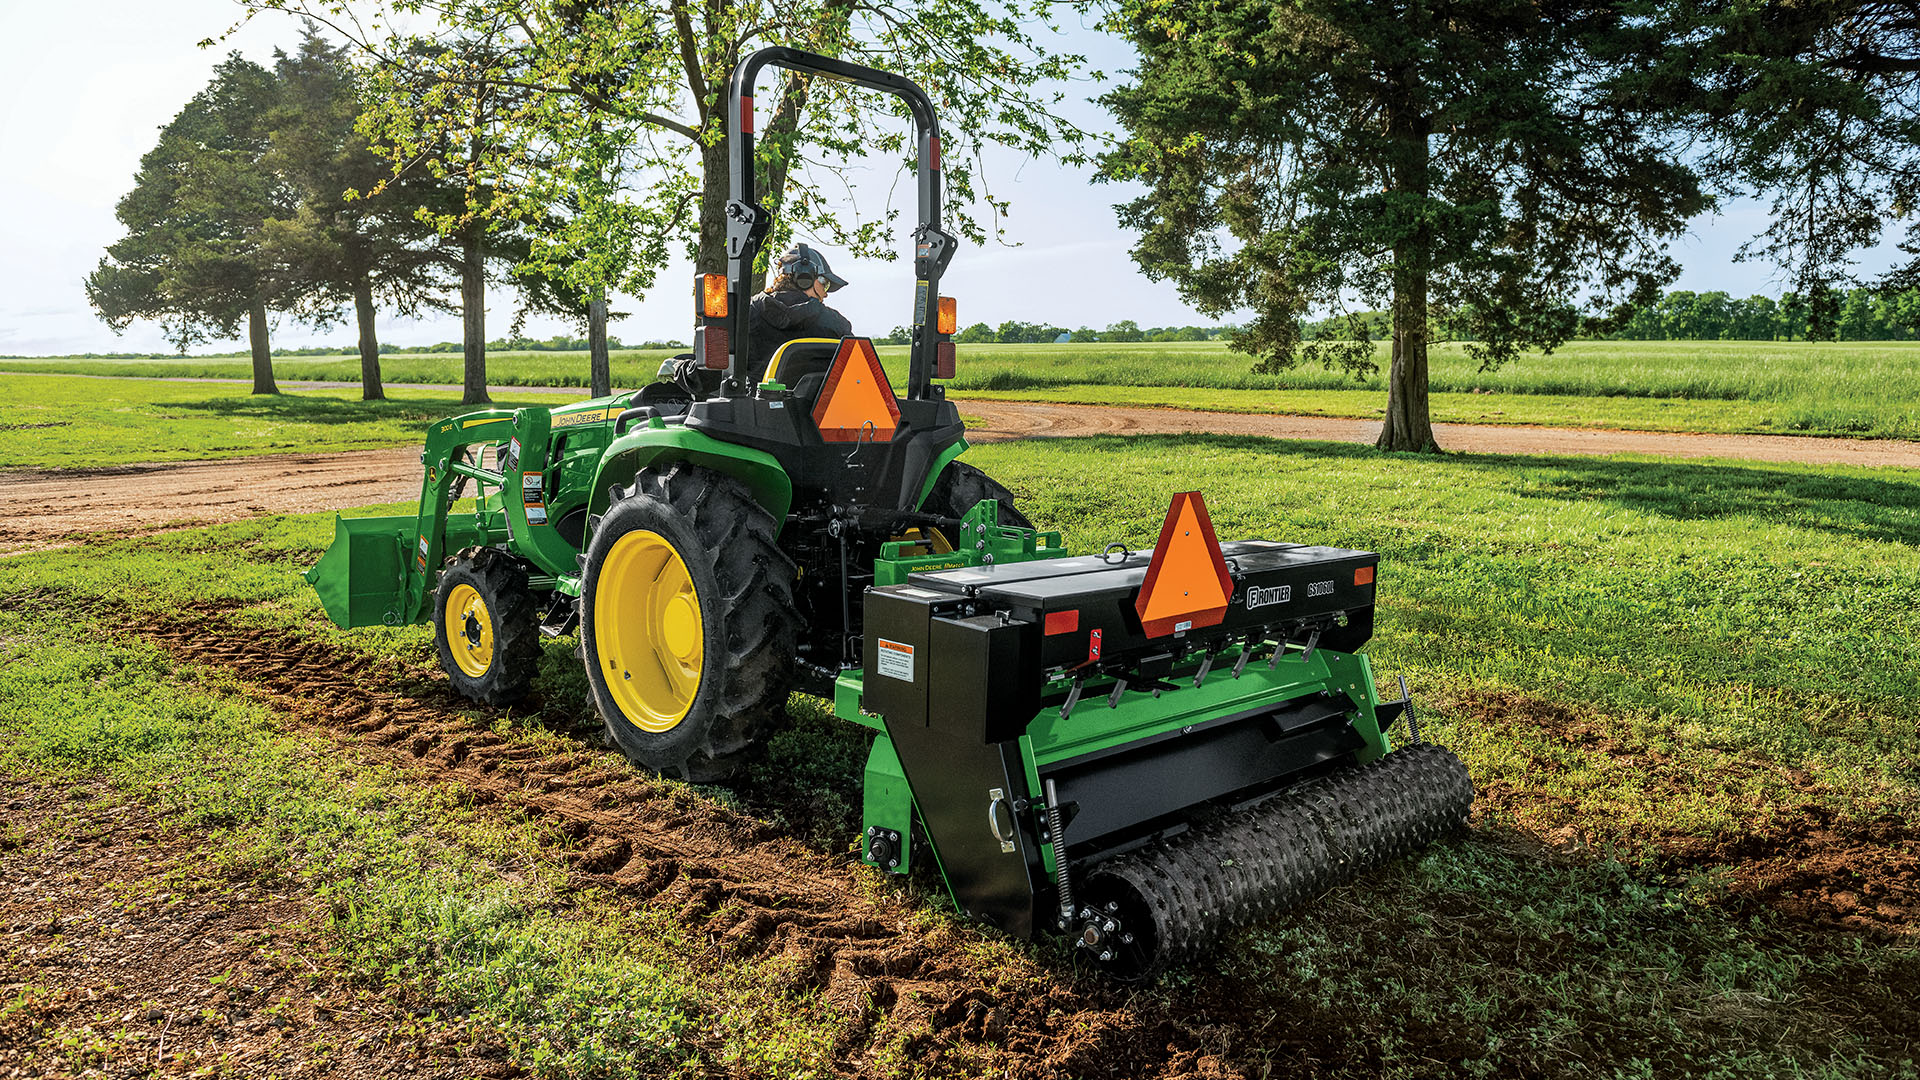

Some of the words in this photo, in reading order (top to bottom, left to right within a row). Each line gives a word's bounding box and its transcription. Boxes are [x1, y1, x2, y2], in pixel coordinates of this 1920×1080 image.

[557, 416, 575, 425] JOHN
[576, 413, 602, 423] DEERE
[1247, 585, 1291, 610] FRONTIER
